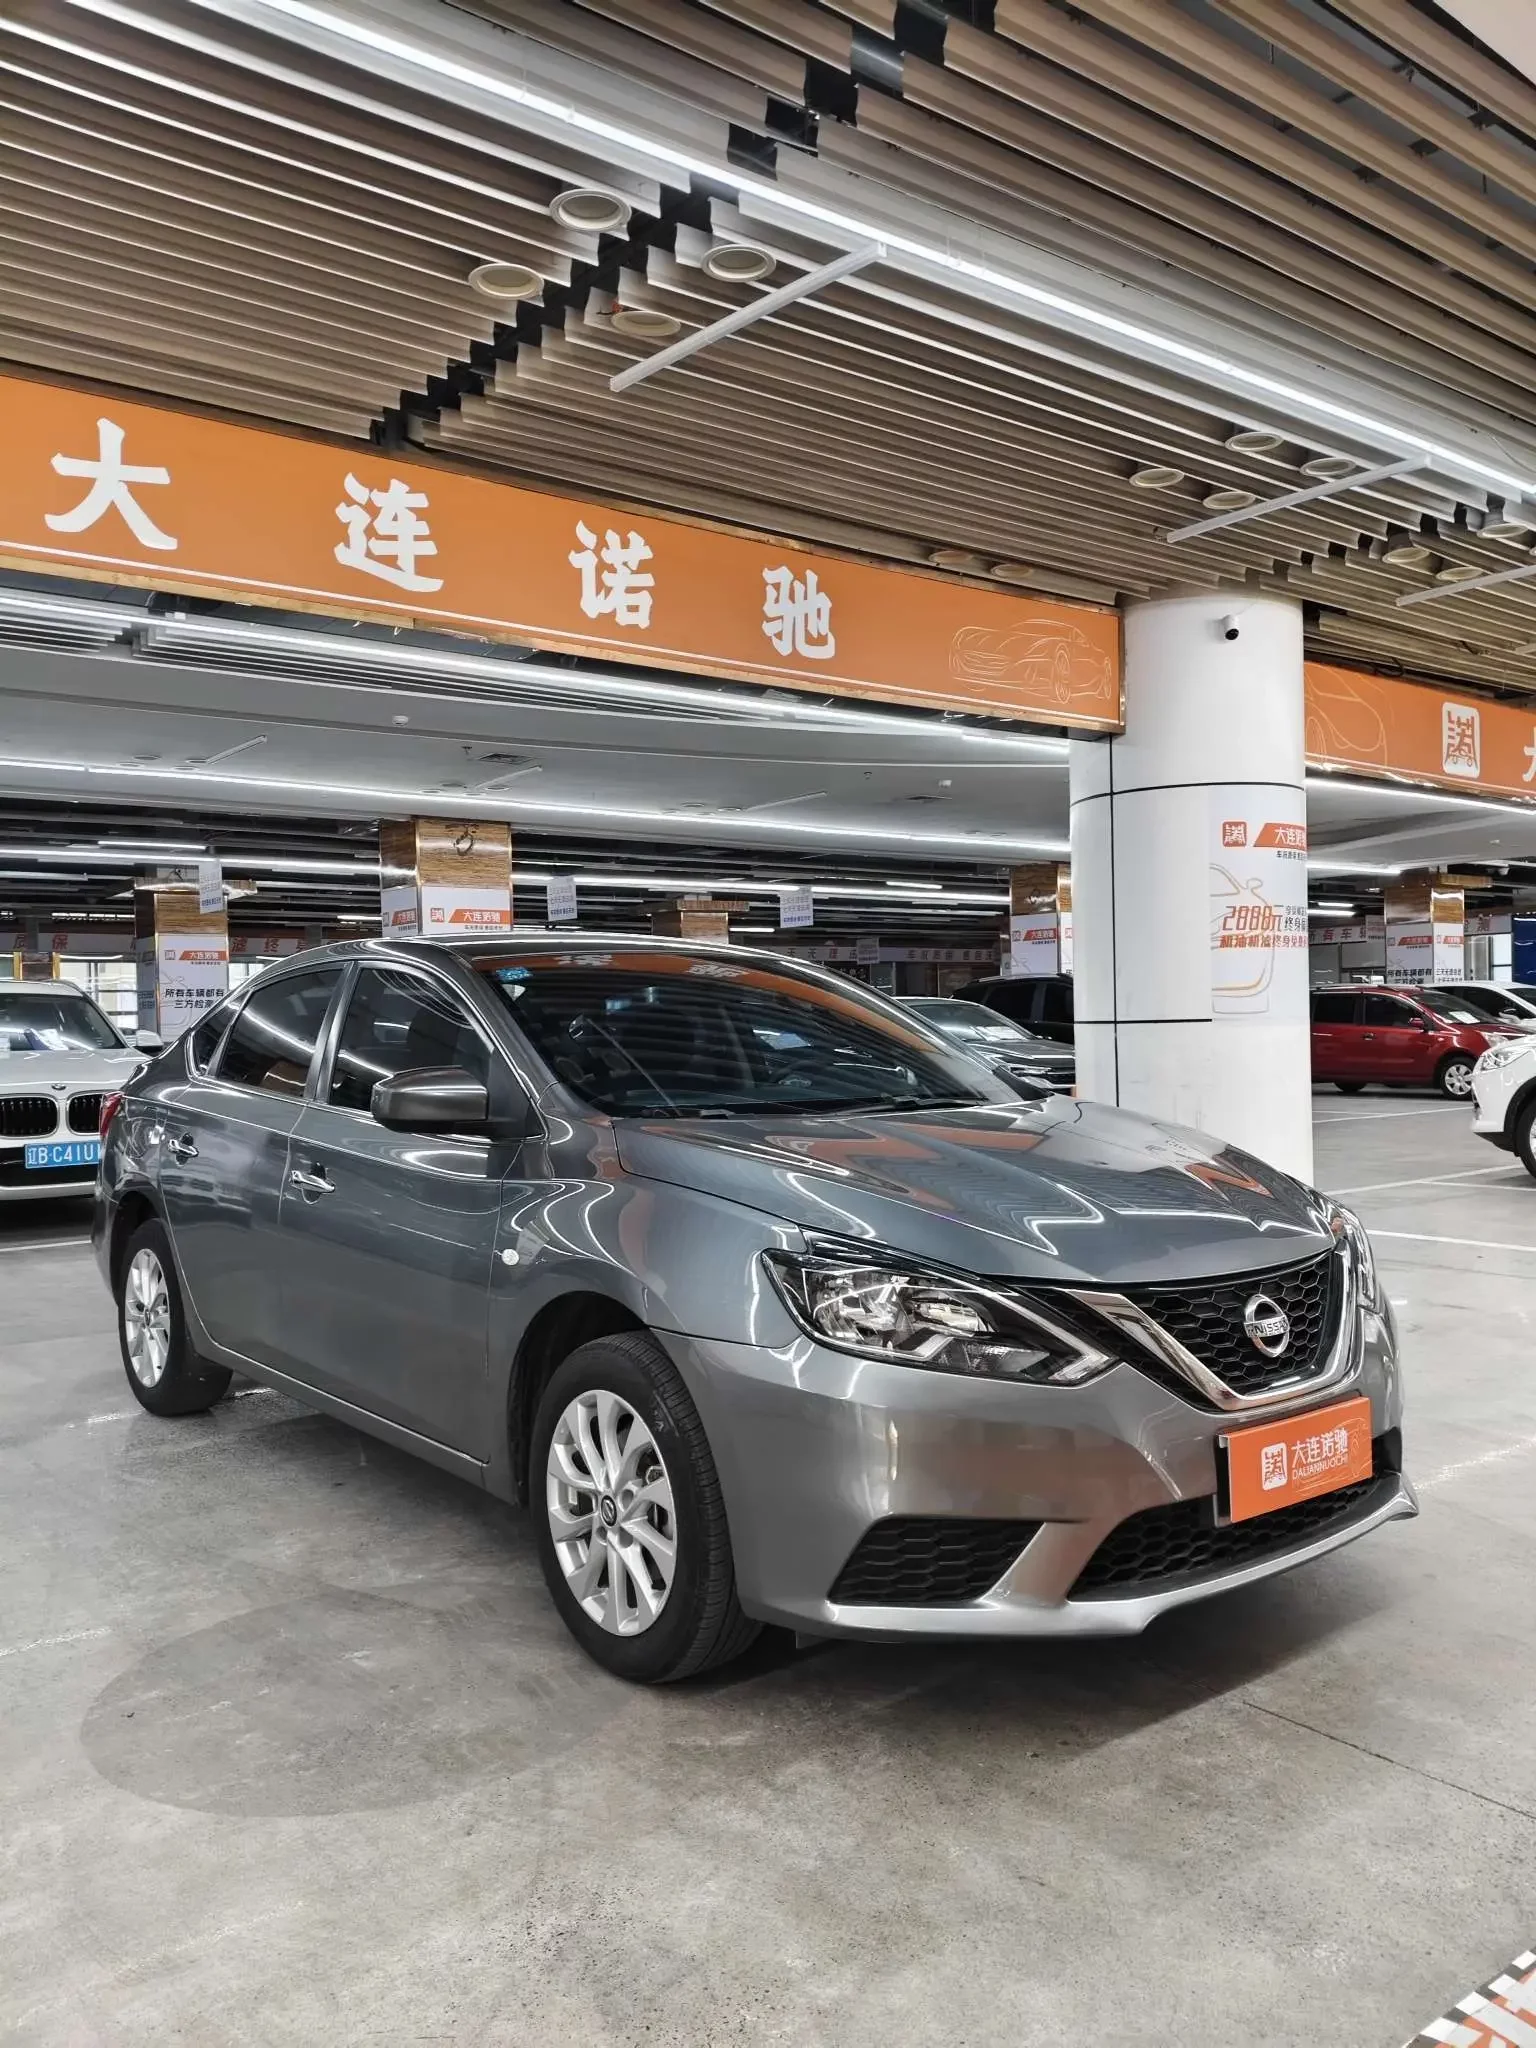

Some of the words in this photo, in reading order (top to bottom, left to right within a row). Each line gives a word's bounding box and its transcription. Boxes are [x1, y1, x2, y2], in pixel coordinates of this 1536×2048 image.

[44, 417, 836, 660] 大连诺驰
[165, 988, 224, 998] 所有车辆都有
[1291, 1428, 1348, 1468] 大连诺驰
